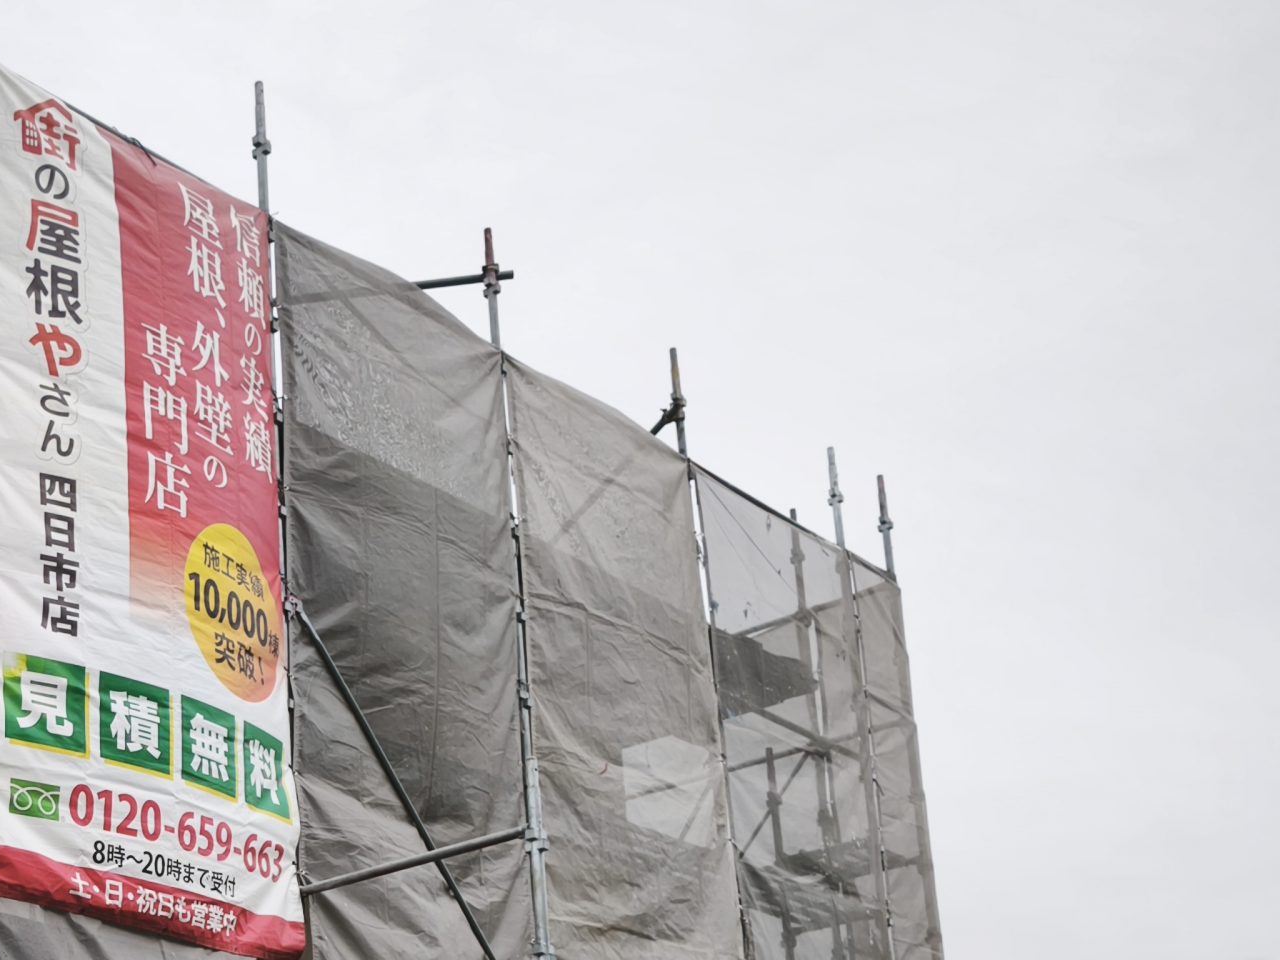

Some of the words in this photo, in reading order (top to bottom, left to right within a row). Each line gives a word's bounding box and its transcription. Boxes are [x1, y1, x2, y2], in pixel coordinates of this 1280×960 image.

[14, 98, 83, 457] 街の屋根やさん
[177, 181, 234, 488] 屋根、外壁の
[230, 203, 273, 485] 信頼の実績
[141, 322, 192, 519] 専門店
[39, 472, 80, 637] 四日市店
[203, 541, 265, 602] 施工実績
[16, 670, 280, 806] 見積無料
[69, 783, 285, 883] 0120-659-663
[69, 871, 238, 937] 土・日・祝日も営業中
